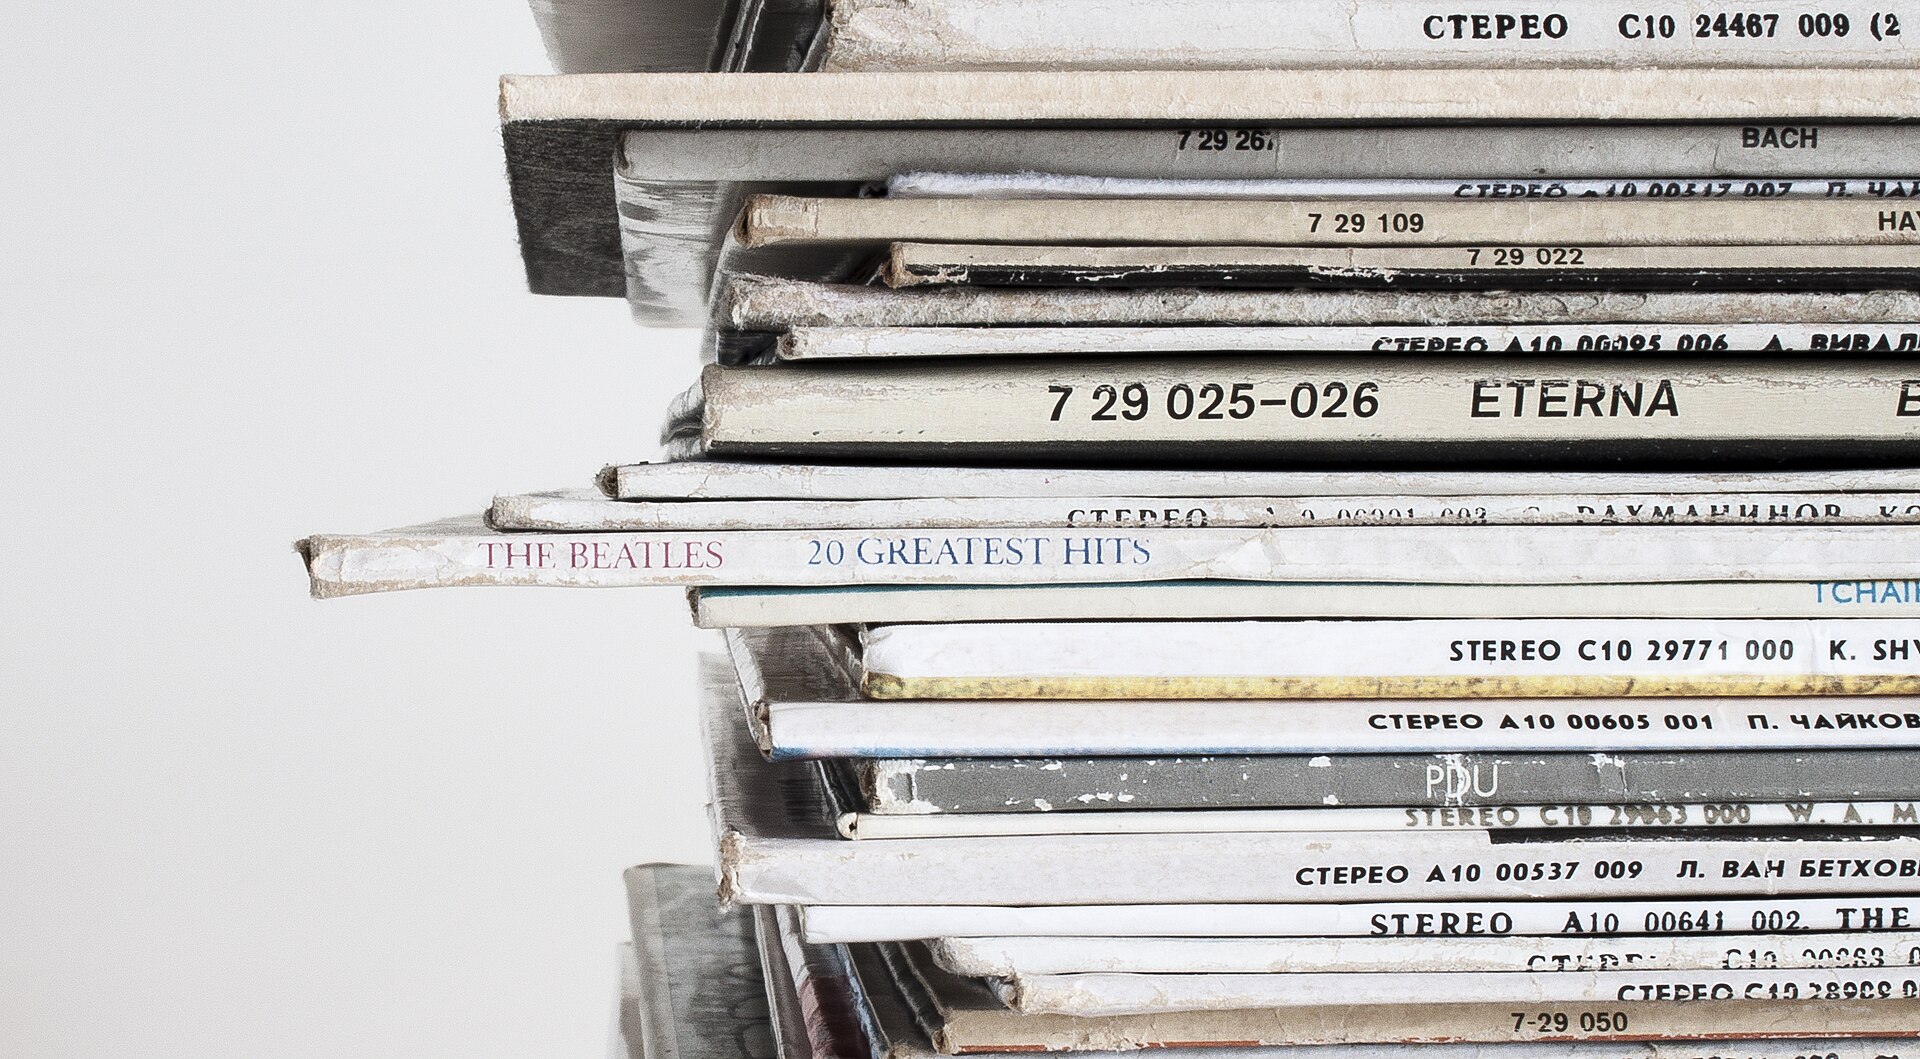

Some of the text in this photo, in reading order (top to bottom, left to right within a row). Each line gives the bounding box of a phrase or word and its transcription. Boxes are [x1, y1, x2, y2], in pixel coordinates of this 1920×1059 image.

[1423, 12, 1901, 42] СТЕРЕО С10 24467 009 (2
[1178, 130, 1192, 150] 7
[1198, 130, 1228, 151] 29
[1742, 127, 1818, 148] BACH
[1308, 211, 1920, 233] 7 29 109 HA
[1466, 248, 1584, 265] 7 29 022
[1810, 333, 1920, 351] ВИВАЛ
[1048, 385, 1073, 421] 7
[1091, 384, 1148, 421] 29
[1471, 379, 1679, 418] ETERNA
[478, 537, 1150, 569] THE BEATLES 20 GREATEST HITS
[1450, 640, 1561, 661] STEREO
[1578, 640, 1632, 661] C10
[1648, 640, 1727, 661] 29771
[1745, 640, 1794, 660] 000
[1830, 640, 1855, 660] K.
[1368, 714, 1483, 730] СТЕРЕО
[1500, 714, 1555, 730] А10
[1567, 714, 1650, 730] 00605
[1664, 714, 1713, 730] 001
[1748, 715, 1779, 729] П.
[1426, 764, 1498, 798] PDU
[1406, 806, 1520, 827] STEREO
[1704, 804, 1750, 824] 000
[1786, 803, 1825, 823] W.
[1844, 803, 1873, 823] A.
[1296, 859, 1920, 886] СТЕРЕО А10 00537 009 Л. ВАН БЕТХОВ
[1370, 913, 1513, 935] STEREO
[1561, 911, 1619, 932] A10
[1645, 910, 1723, 931] 00641
[1836, 907, 1911, 928] THE
[1511, 1012, 1628, 1032] 7-29 050
